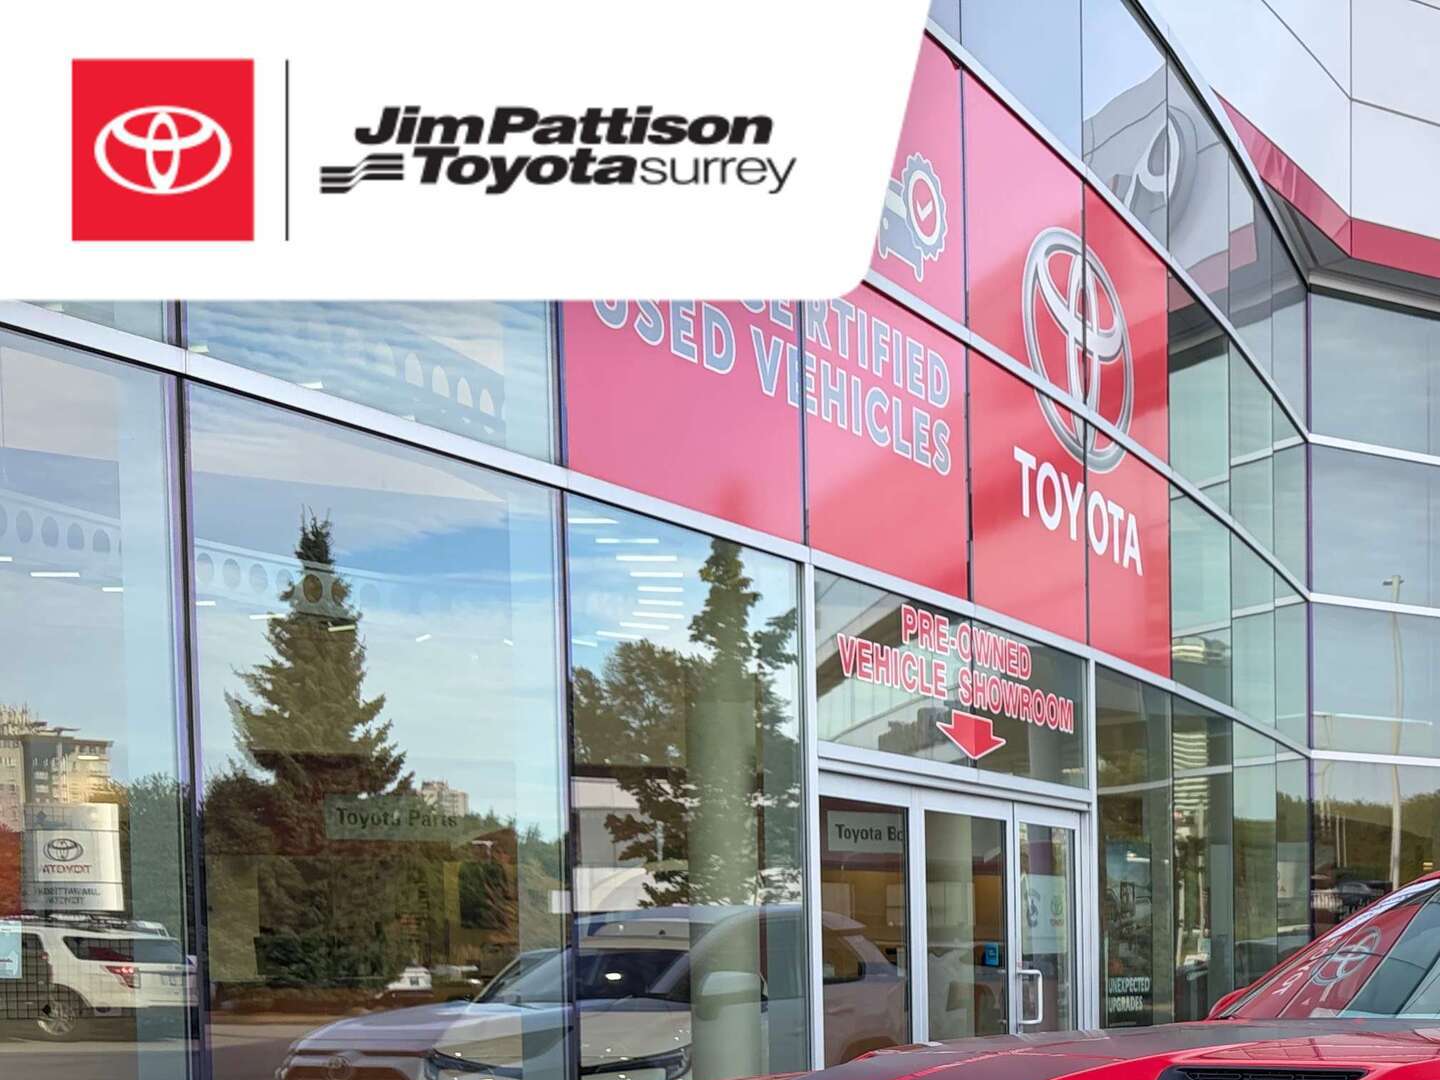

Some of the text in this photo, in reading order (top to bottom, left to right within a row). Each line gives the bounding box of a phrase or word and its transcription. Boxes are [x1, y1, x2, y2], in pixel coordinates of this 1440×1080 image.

[740, 298, 950, 409] ERTIFIED
[750, 324, 951, 476] VEHICLES
[1013, 445, 1144, 577] TOYOTA
[837, 633, 1075, 735] VEHICLE SHOWROOM
[901, 603, 1032, 681] PRE-OWNED
[336, 807, 458, 829] Toyota Parts
[834, 823, 882, 843] Toyota
